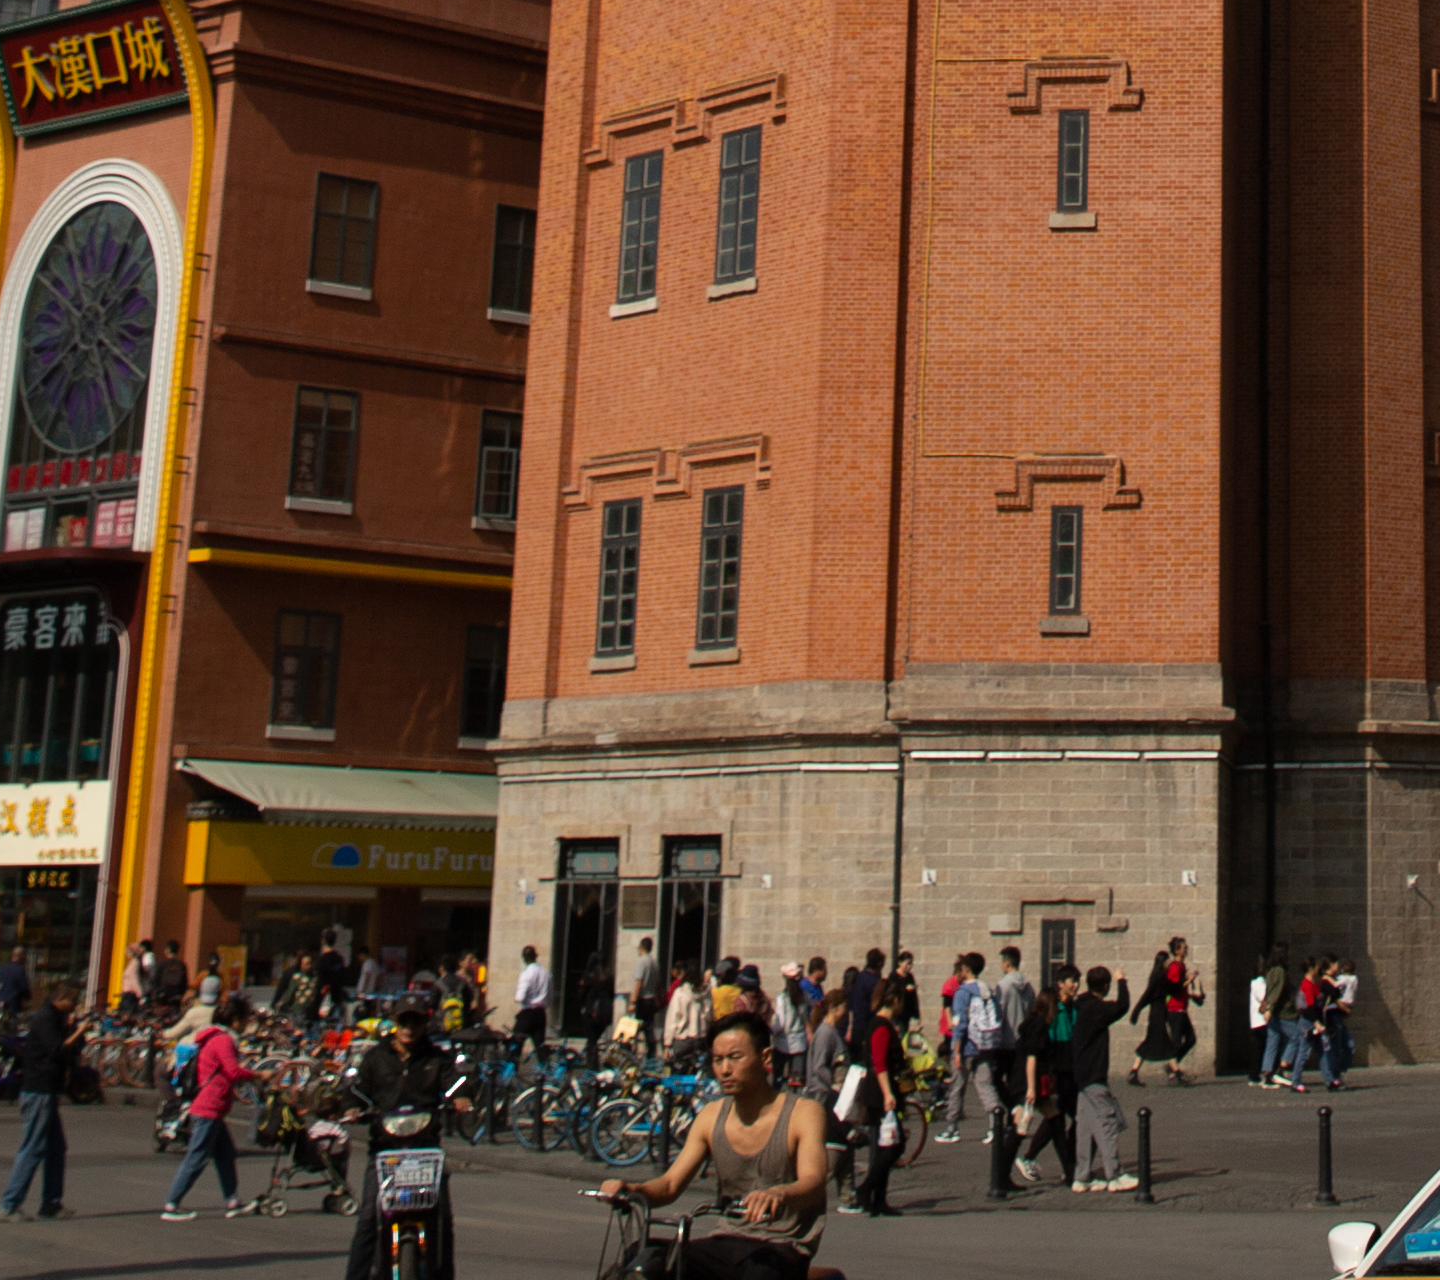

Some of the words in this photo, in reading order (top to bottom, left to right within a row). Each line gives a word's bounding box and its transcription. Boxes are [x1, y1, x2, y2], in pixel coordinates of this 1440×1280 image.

[11, 16, 170, 108] 大漢口城
[367, 844, 494, 872] FuruFuru
